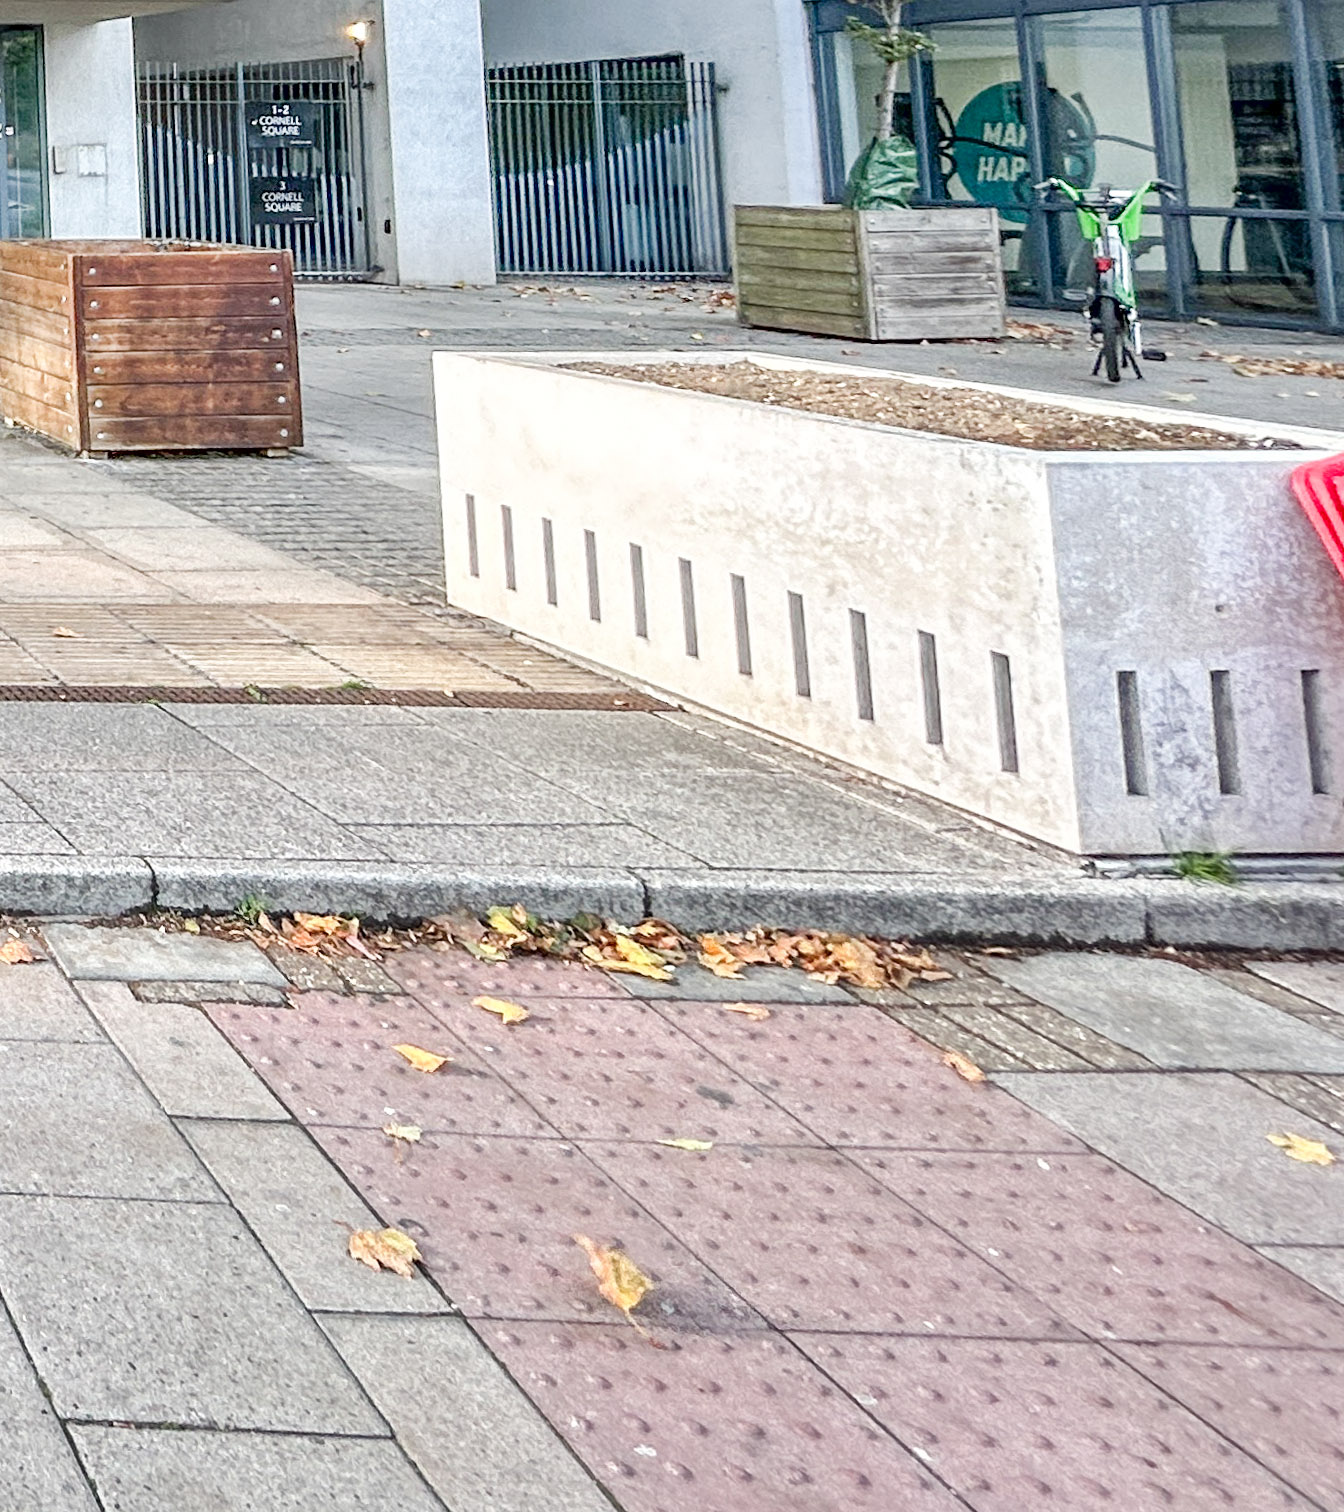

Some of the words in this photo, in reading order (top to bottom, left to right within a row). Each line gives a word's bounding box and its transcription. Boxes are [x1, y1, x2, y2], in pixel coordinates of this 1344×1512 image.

[272, 105, 289, 115] 1-2
[259, 116, 302, 126] CORNELL
[261, 126, 300, 136] SQUARE
[279, 181, 287, 191] 3
[261, 192, 304, 202] CORNELL
[264, 202, 302, 212] SQUARE
